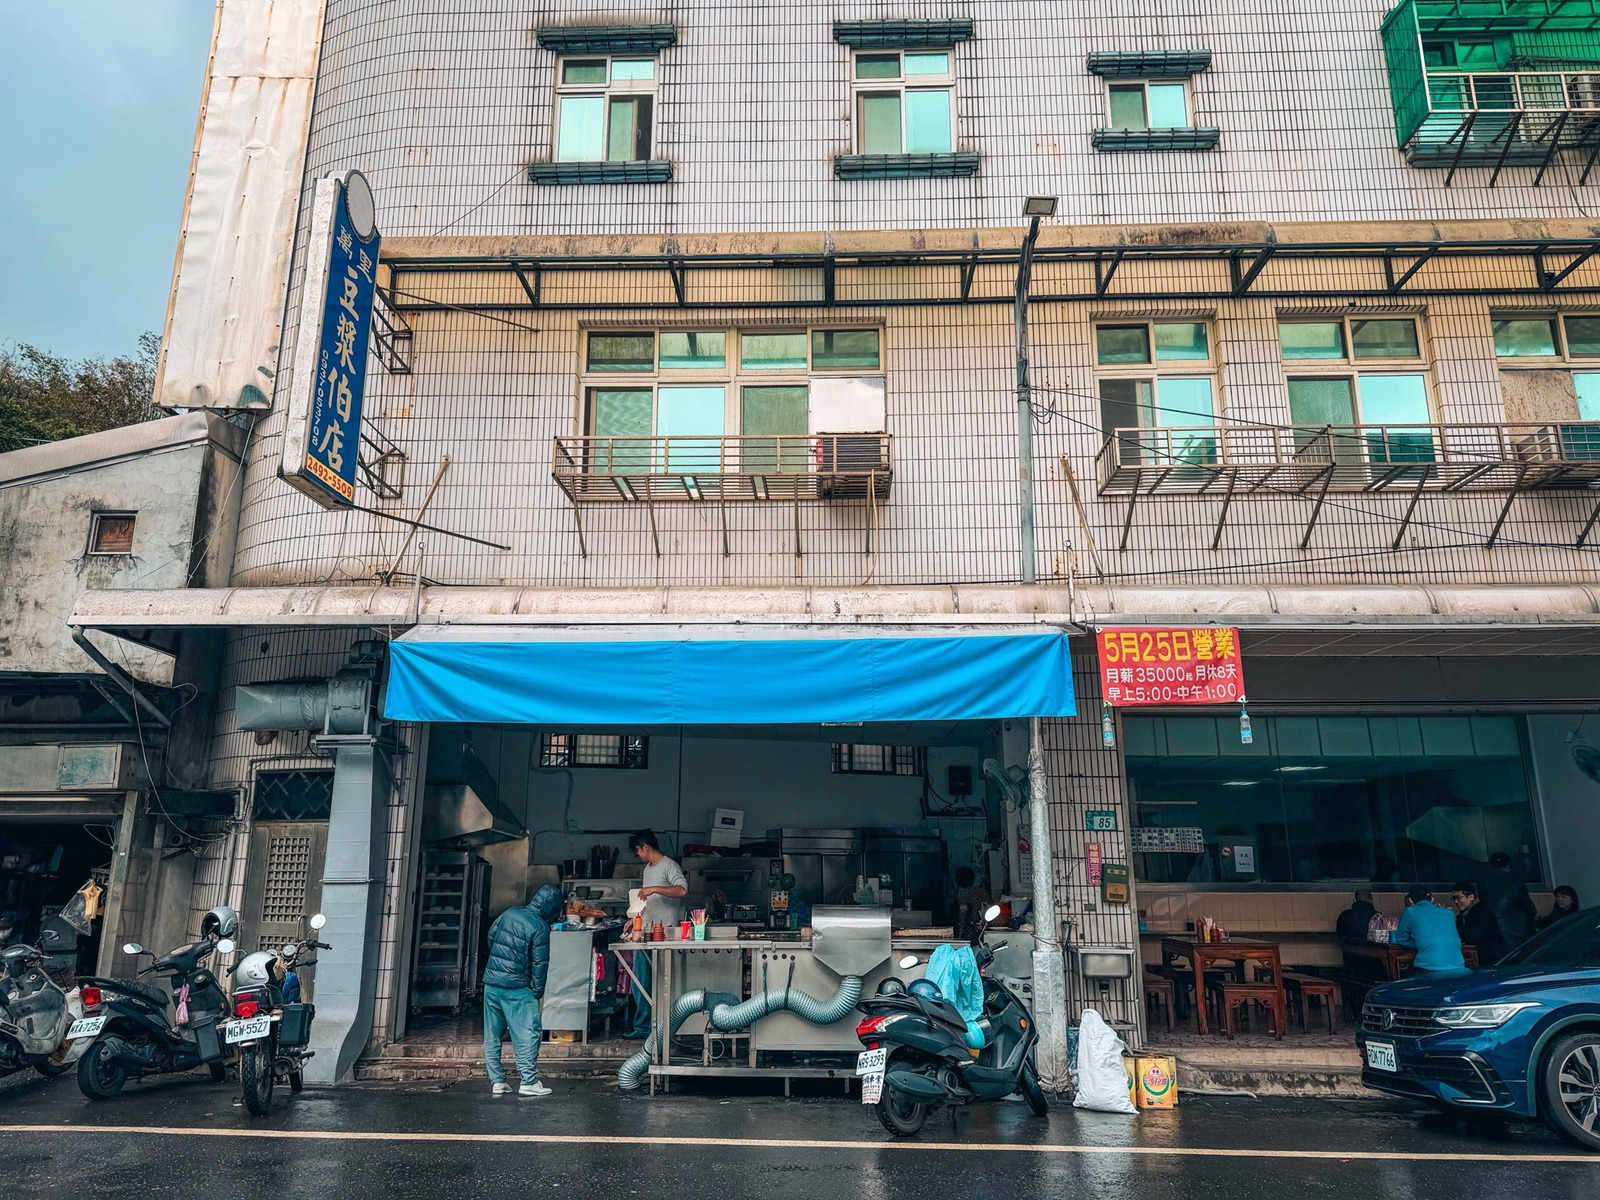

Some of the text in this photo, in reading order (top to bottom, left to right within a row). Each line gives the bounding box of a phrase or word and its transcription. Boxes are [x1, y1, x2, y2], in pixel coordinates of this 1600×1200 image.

[318, 264, 360, 473] 豆漿伯店
[307, 456, 352, 499] 2492-5509
[1104, 628, 1236, 662] 5月25日營業
[1098, 817, 1111, 829] 85
[227, 1020, 269, 1039] MGW-5527
